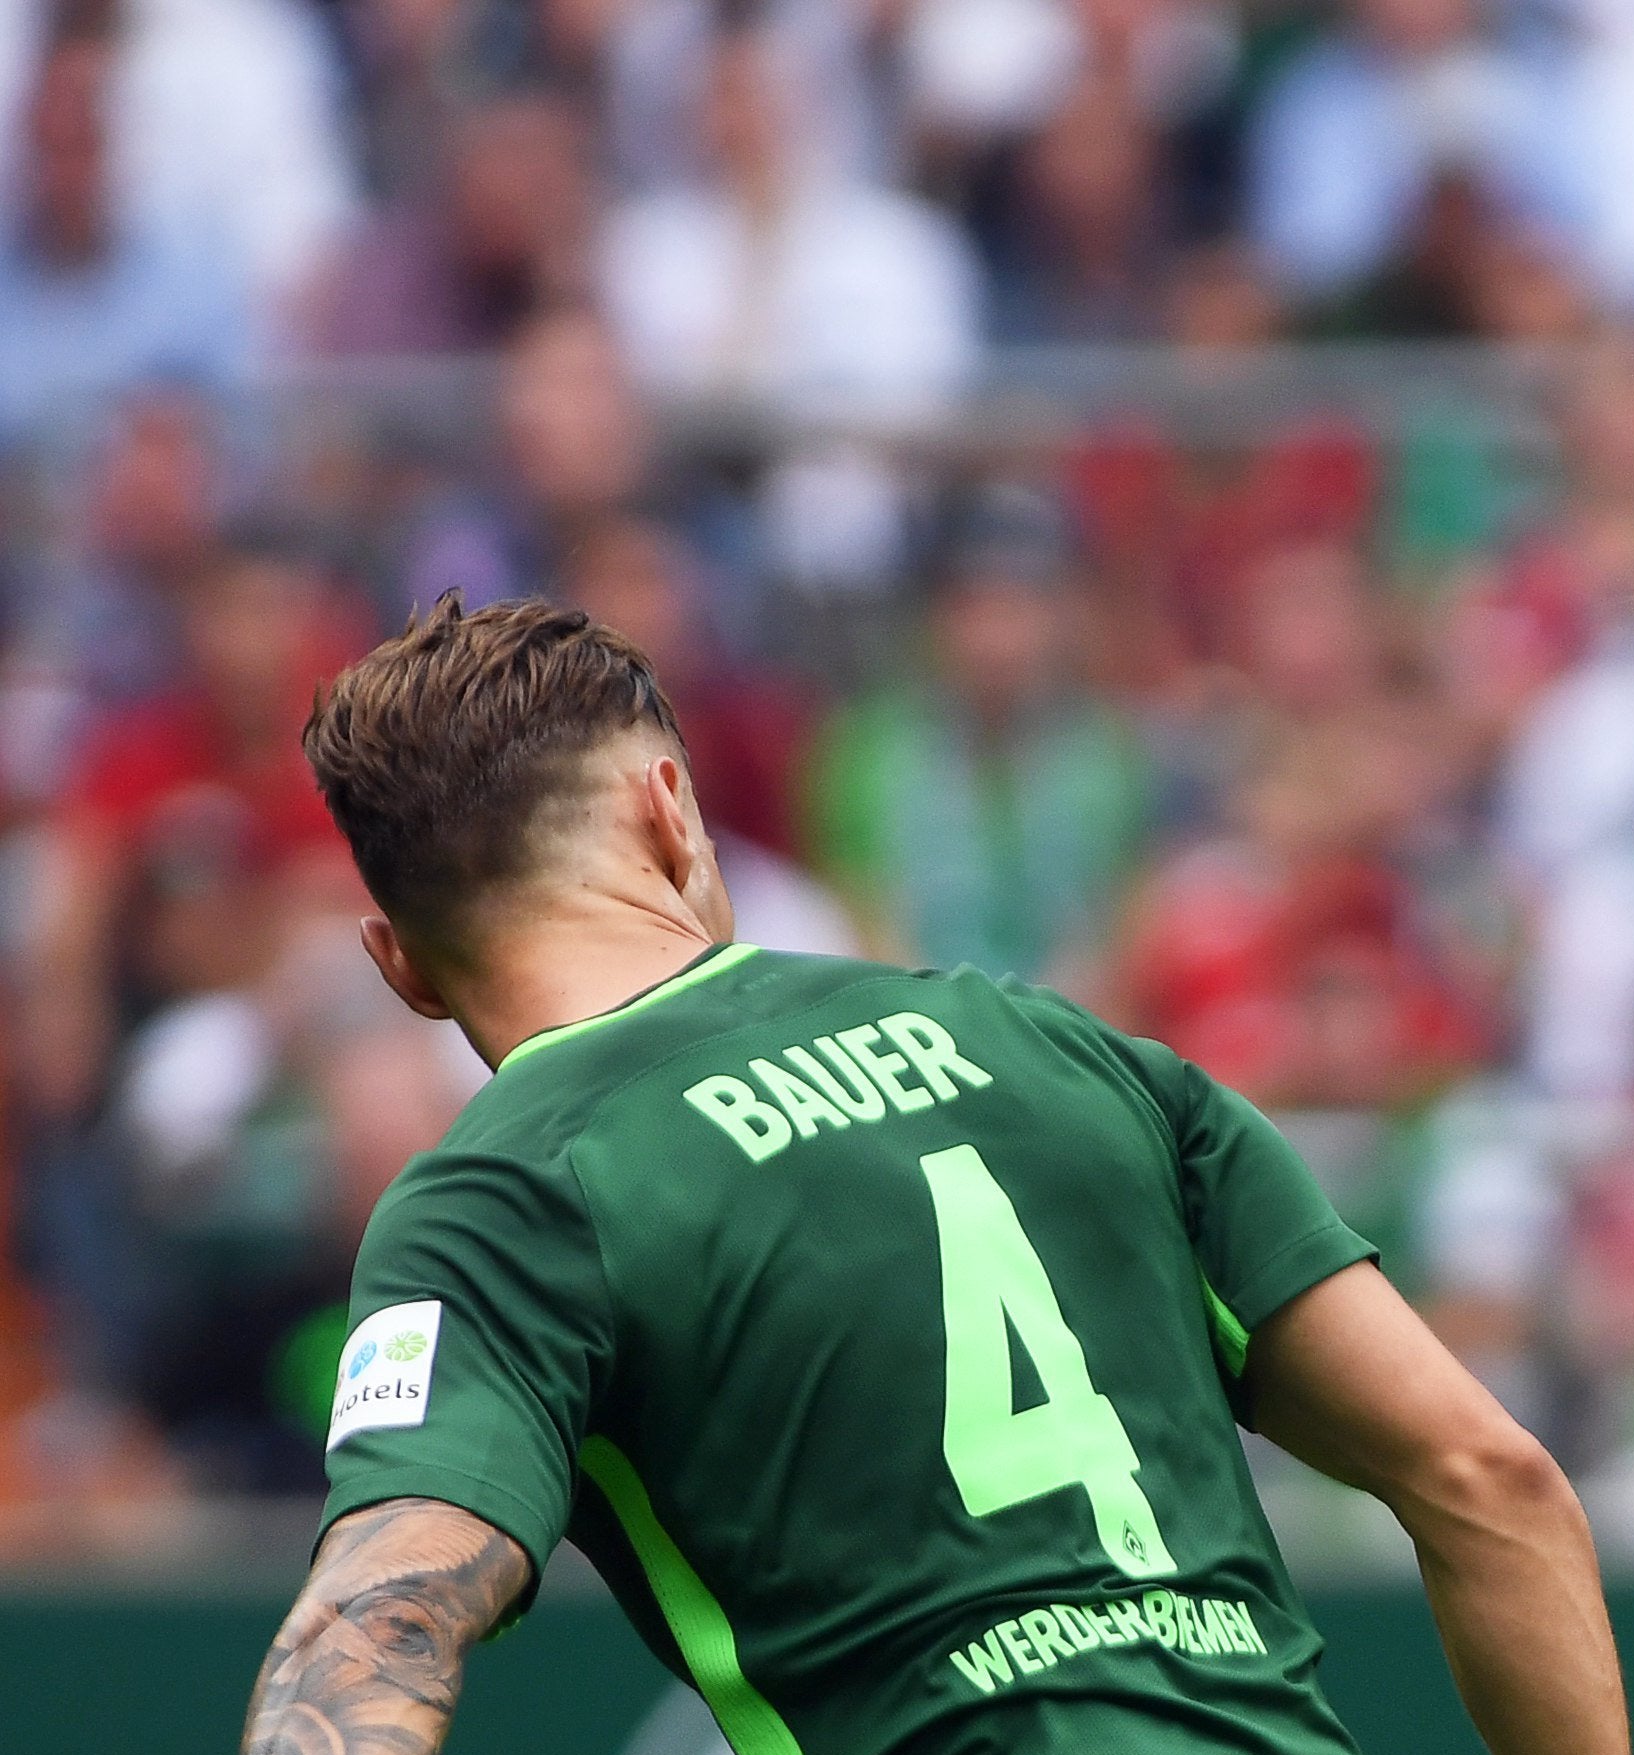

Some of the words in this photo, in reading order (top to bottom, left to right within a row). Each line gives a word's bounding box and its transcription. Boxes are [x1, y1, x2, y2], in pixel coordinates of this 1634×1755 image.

[682, 1010, 994, 1163] BAUER
[919, 1143, 1178, 1578] 4
[949, 1599, 1156, 1688] WERDER
